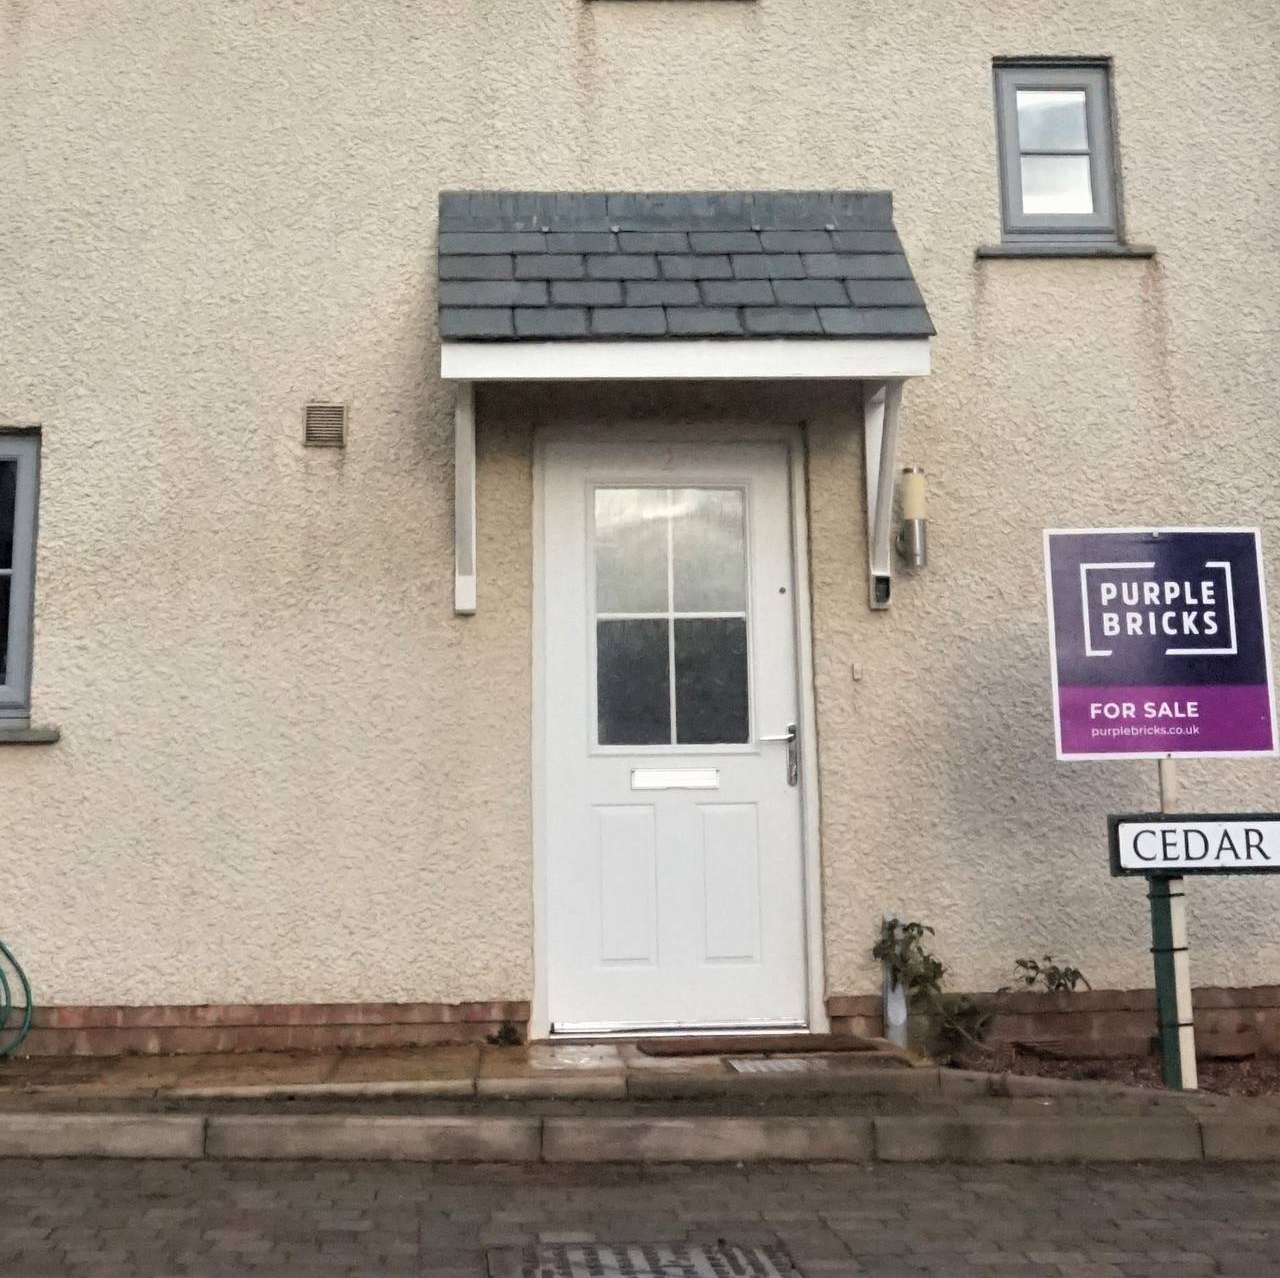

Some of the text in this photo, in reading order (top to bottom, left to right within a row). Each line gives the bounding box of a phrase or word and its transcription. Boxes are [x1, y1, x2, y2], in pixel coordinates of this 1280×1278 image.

[1100, 581, 1216, 606] PURPLE
[1102, 610, 1219, 636] BRICKS
[1090, 701, 1200, 720] FOR SALE
[1091, 724, 1200, 738] purplebricks.co.uk
[1132, 827, 1271, 862] CEDAR
